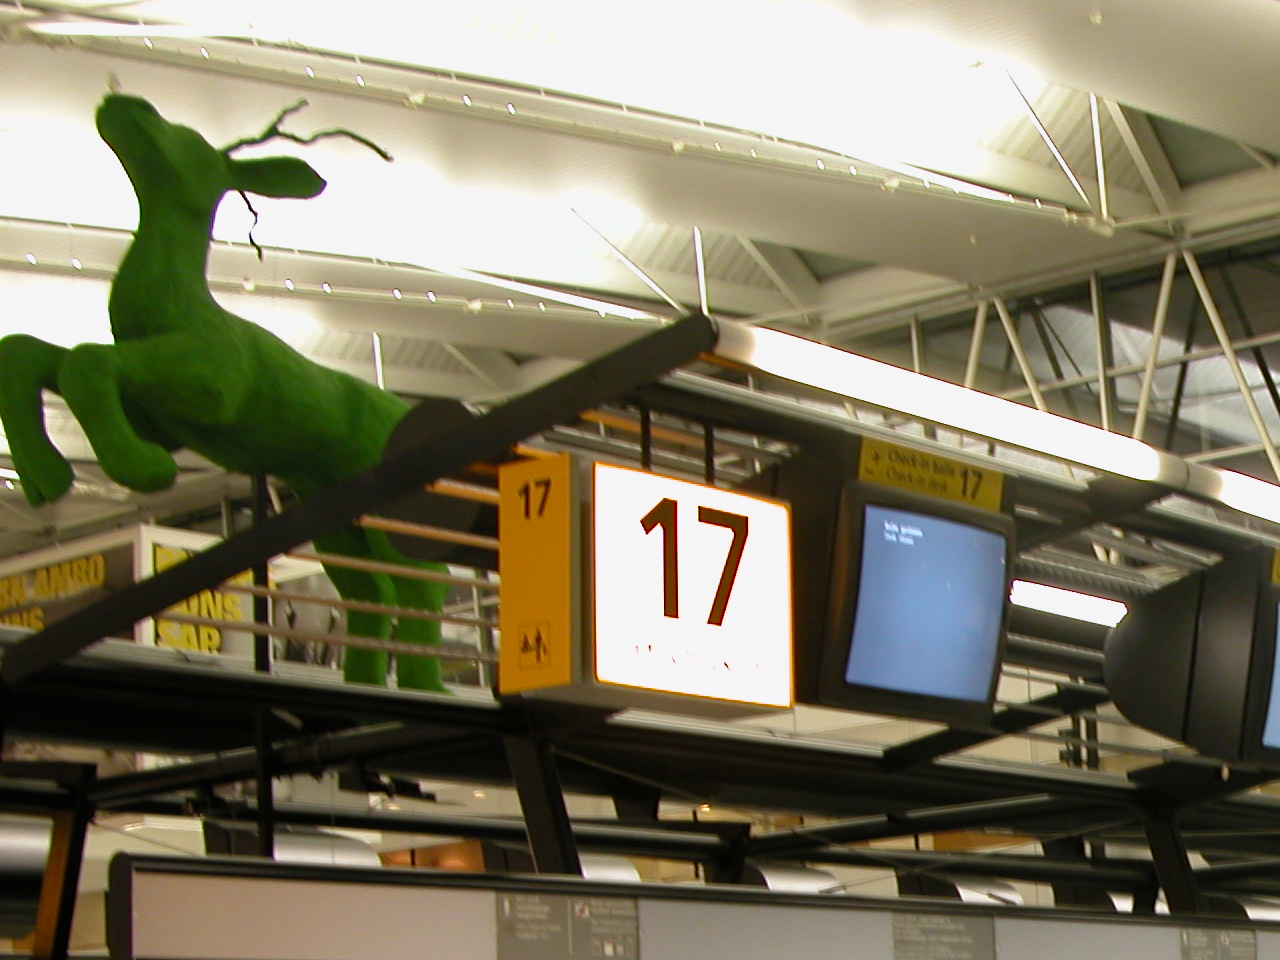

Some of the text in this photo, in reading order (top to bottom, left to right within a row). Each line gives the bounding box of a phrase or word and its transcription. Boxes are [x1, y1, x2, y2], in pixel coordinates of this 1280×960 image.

[518, 477, 552, 519] 17
[960, 467, 984, 499] 17
[640, 497, 749, 627] 17
